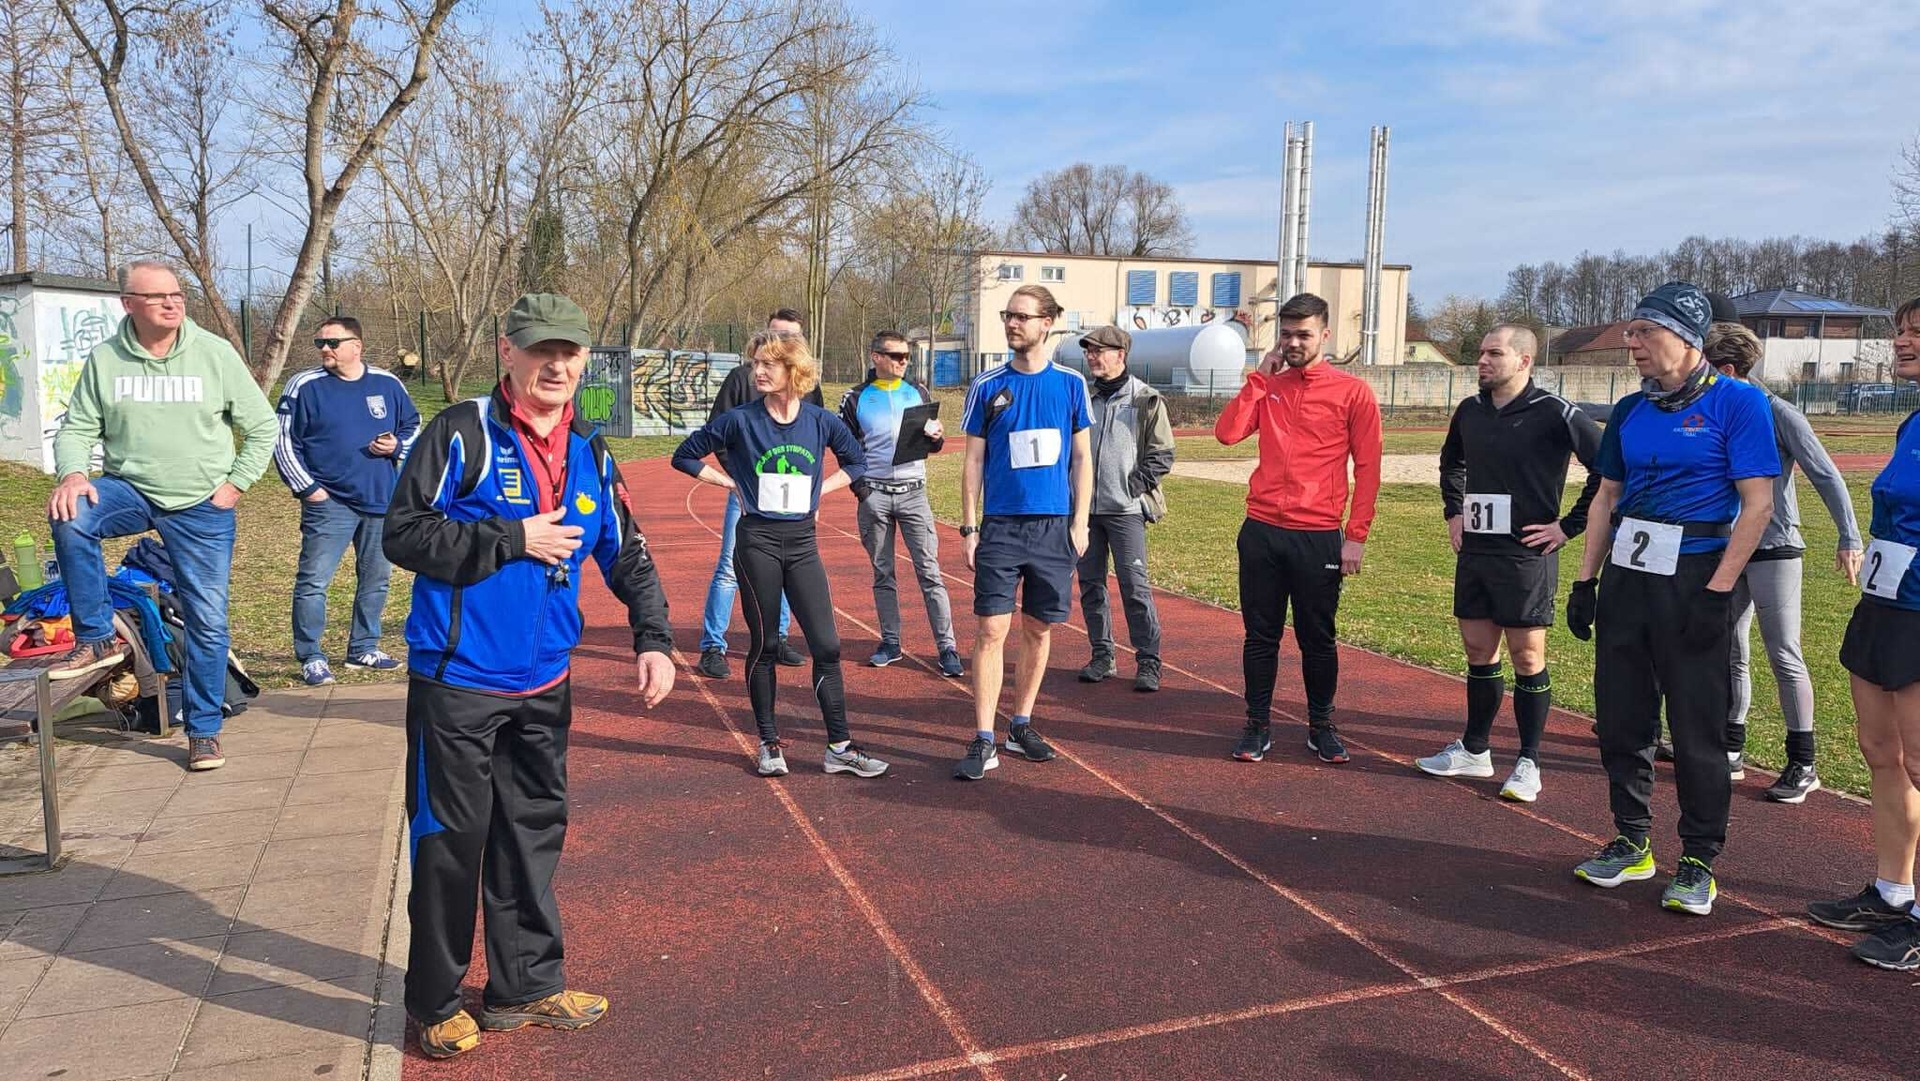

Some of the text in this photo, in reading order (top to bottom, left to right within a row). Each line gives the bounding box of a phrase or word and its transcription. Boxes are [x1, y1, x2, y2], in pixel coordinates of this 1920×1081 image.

[114, 375, 203, 402] PUMA
[1030, 437, 1040, 463] 1
[780, 482, 789, 509] 1
[1471, 502, 1493, 531] 31
[1630, 530, 1650, 568] 2
[1866, 551, 1882, 591] 2
